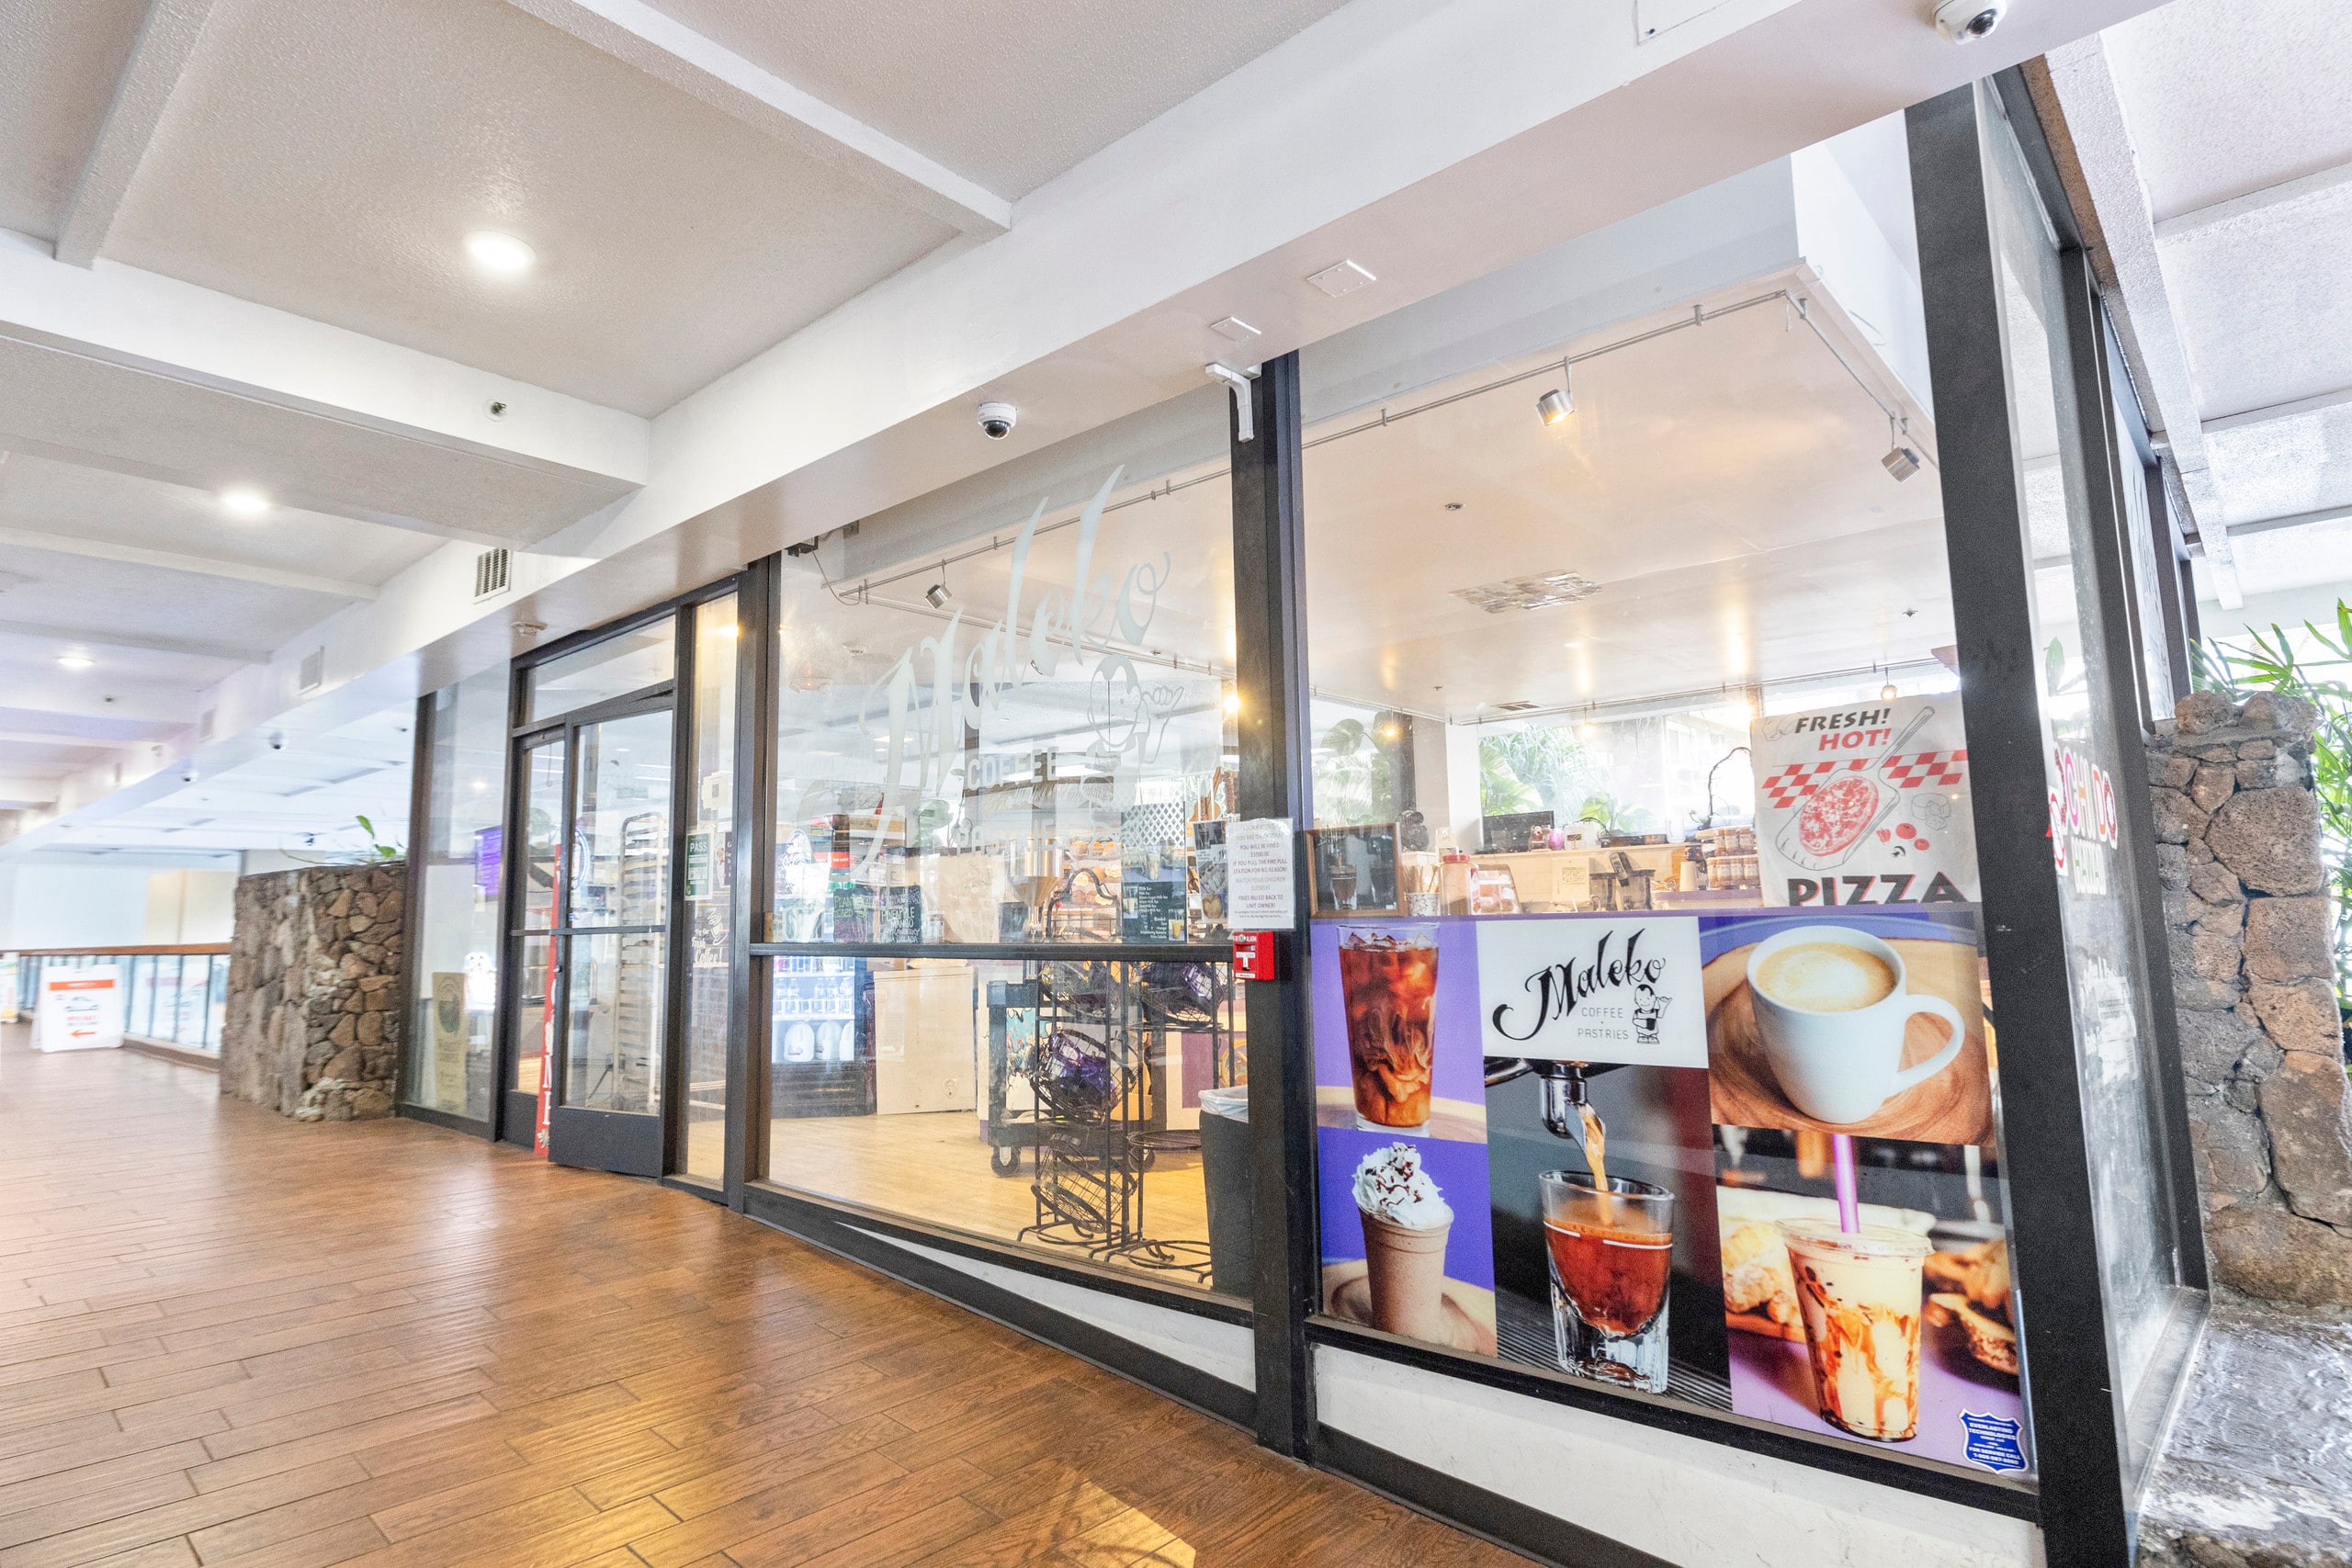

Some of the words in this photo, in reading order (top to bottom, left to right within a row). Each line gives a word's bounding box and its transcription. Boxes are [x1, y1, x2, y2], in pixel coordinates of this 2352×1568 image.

[1795, 708, 1891, 734] FRESH!
[1818, 728, 1892, 751] HOT!
[967, 746, 1059, 790] COFFEE
[690, 841, 707, 852] PASS
[1788, 872, 1969, 908] PIZZA
[695, 947, 723, 967] Coffee!
[1492, 928, 1667, 1041] Maleko
[1581, 1007, 1624, 1019] COFFEE
[1577, 1028, 1630, 1040] PASTRIES
